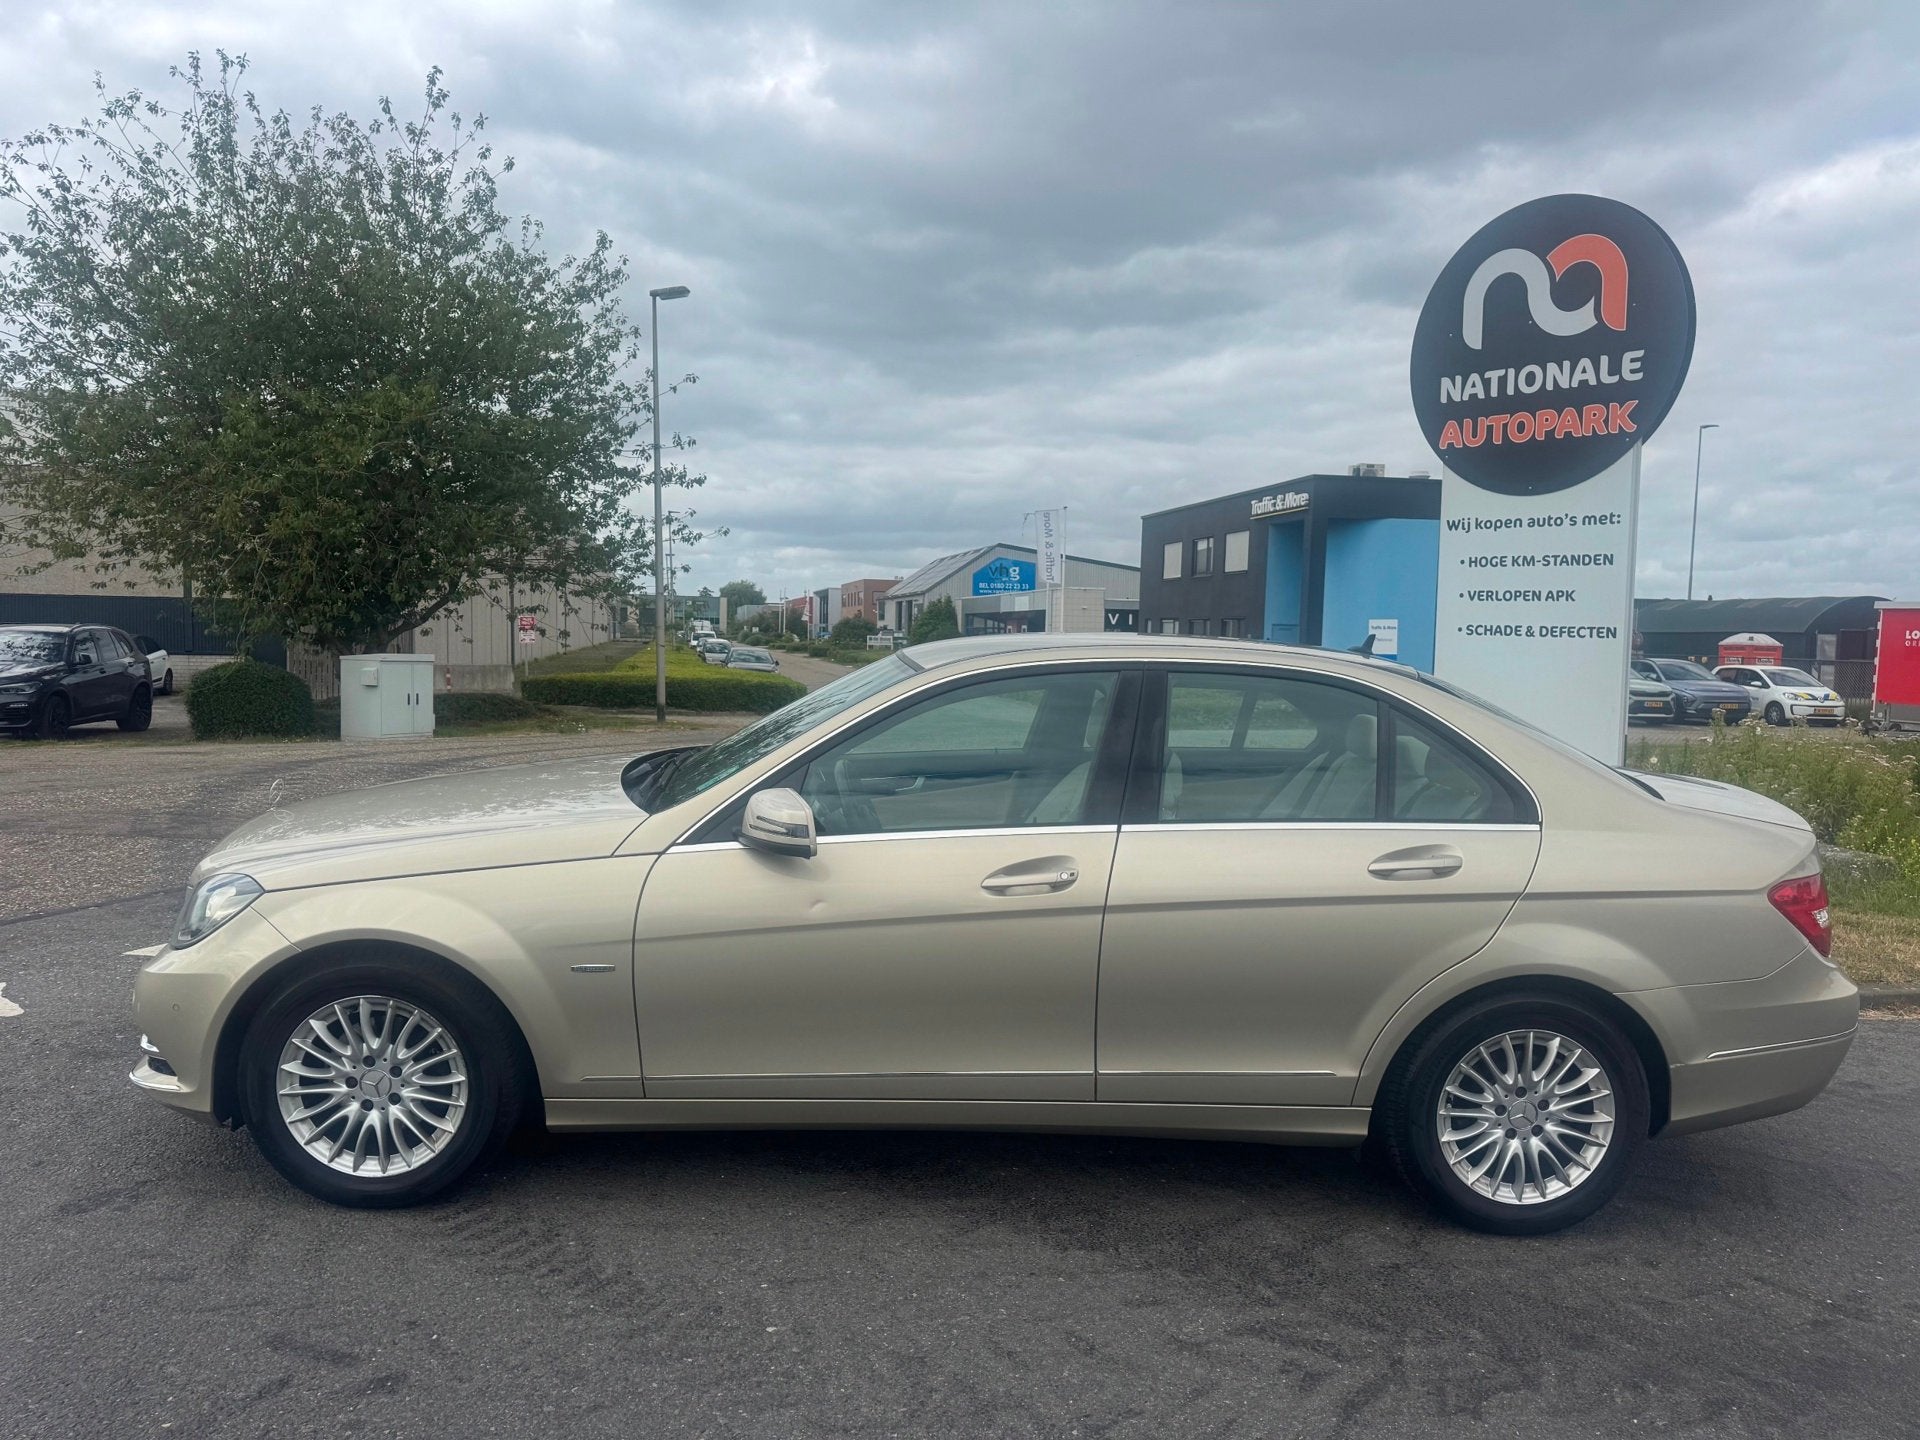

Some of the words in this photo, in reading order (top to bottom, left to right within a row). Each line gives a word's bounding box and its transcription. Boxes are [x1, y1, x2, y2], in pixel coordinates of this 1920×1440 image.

[1439, 349, 1645, 403] NATIONALE
[1438, 400, 1638, 450] AUTOPARK
[1251, 496, 1276, 515] Traffic
[1276, 494, 1286, 510] &
[1285, 492, 1309, 508] More
[1446, 518, 1471, 533] Wij
[1474, 515, 1523, 532] kopen
[1527, 513, 1578, 528] auto's
[1582, 512, 1622, 527] met:
[1468, 555, 1508, 568] HOGE
[1511, 553, 1614, 567] KM-STANDEN
[989, 563, 1020, 580] vhg
[1467, 590, 1542, 602] VERLOPEN
[1545, 589, 1576, 602] APK
[1465, 624, 1523, 637] SCHADE
[1525, 625, 1535, 638] &
[1539, 625, 1618, 639] DEFECTEN
